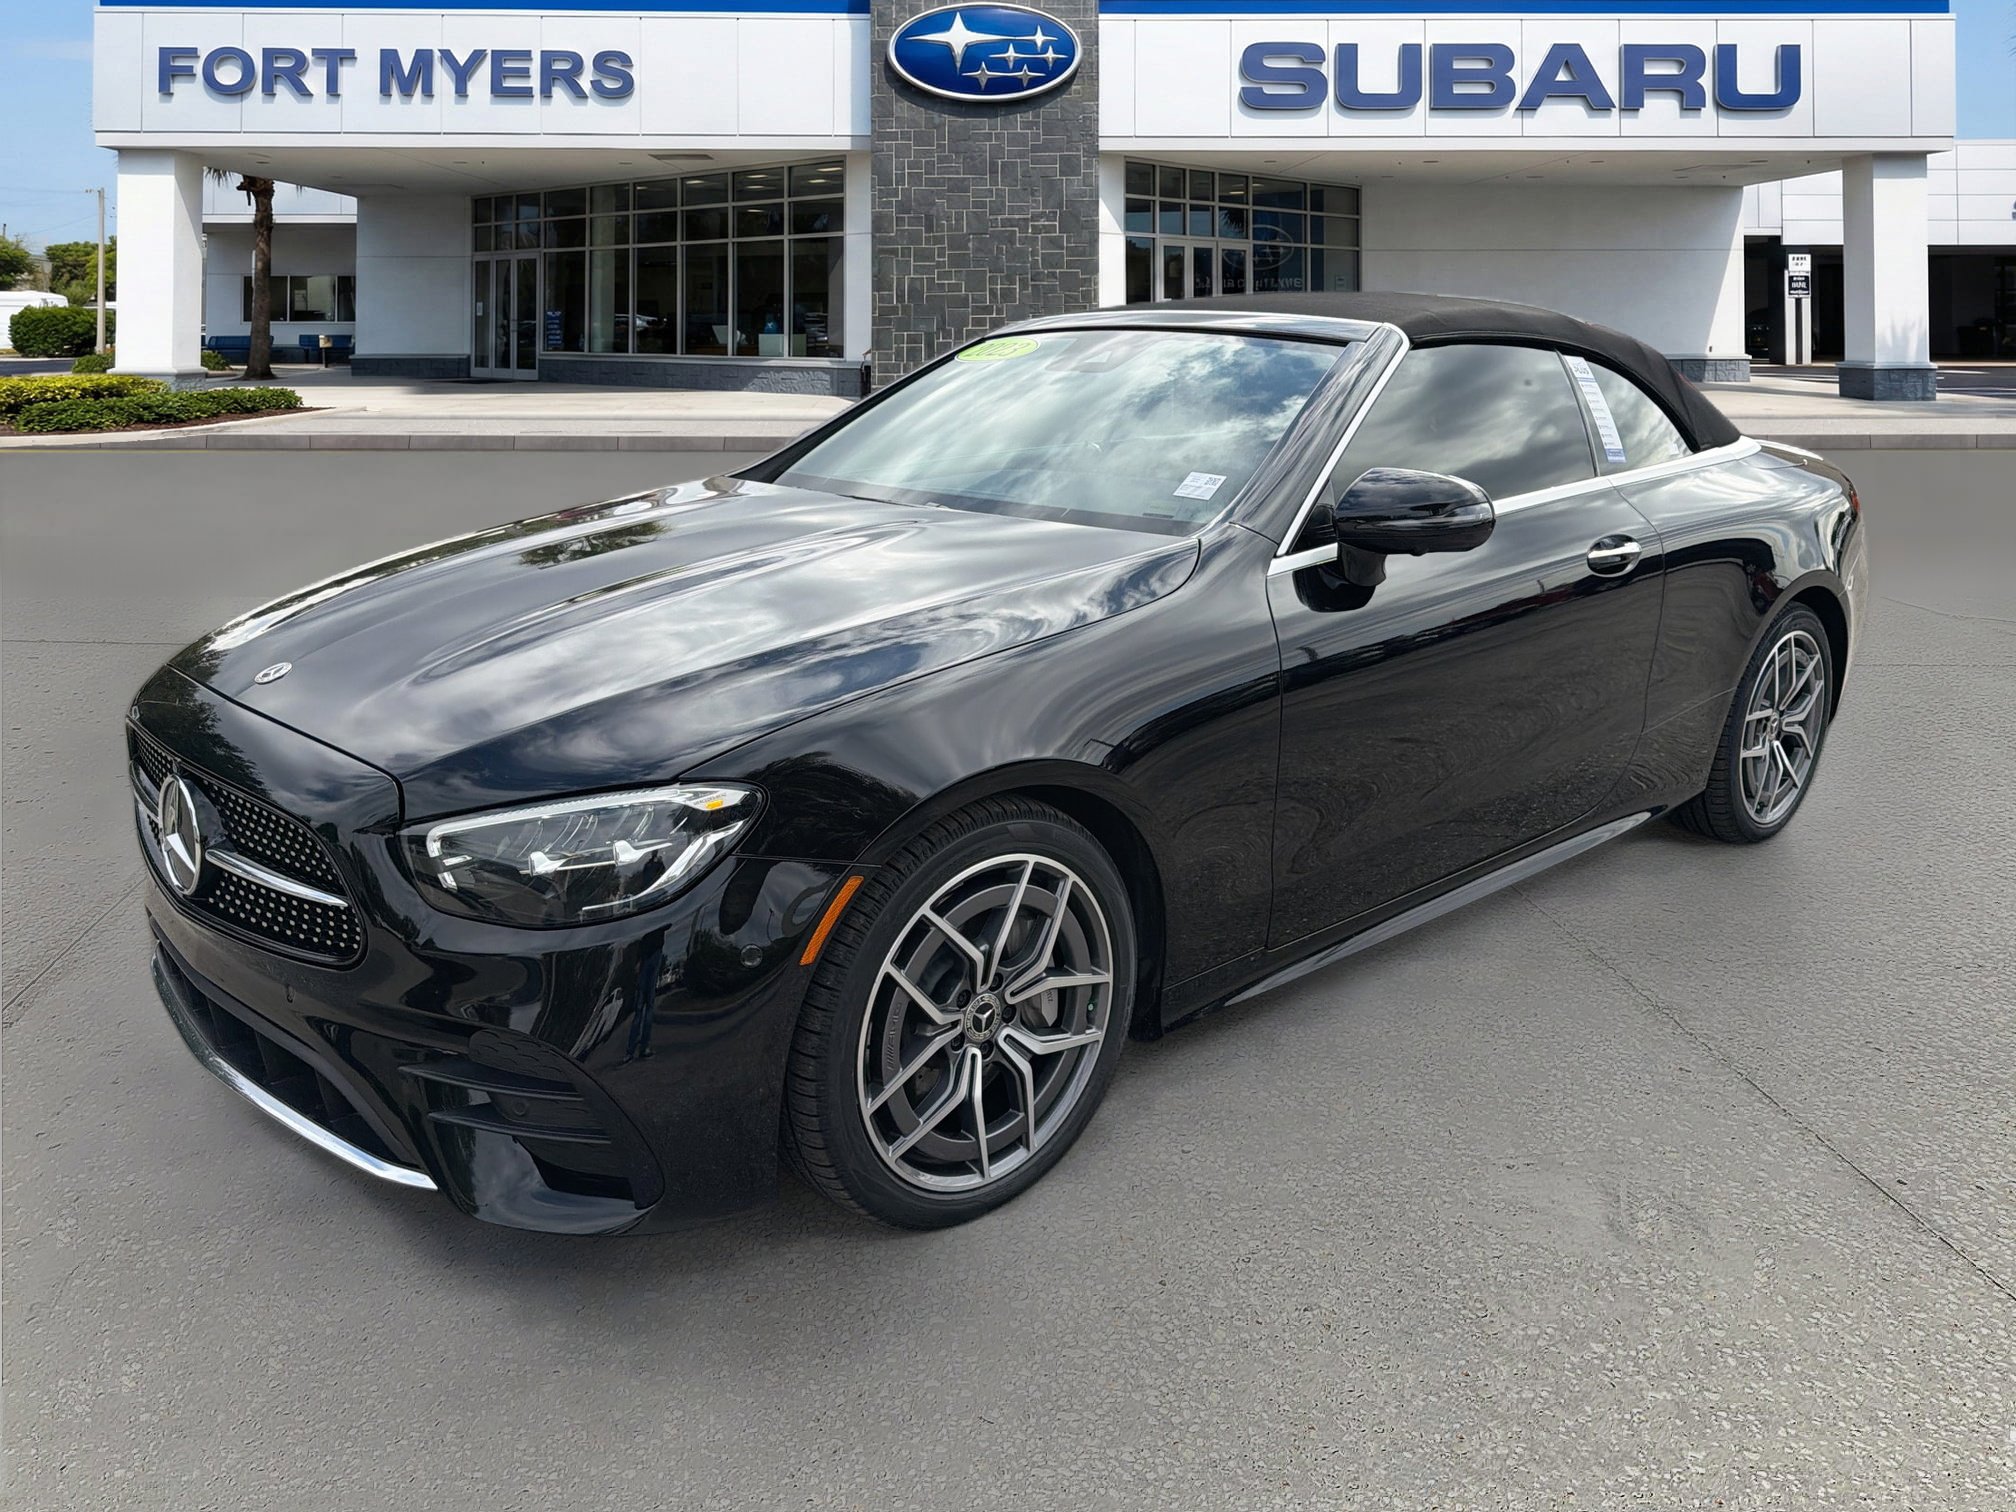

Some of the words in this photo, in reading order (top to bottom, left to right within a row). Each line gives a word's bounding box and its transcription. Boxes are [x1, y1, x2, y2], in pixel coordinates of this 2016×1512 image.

[158, 46, 356, 97] FORT
[379, 48, 636, 99] MYERS
[1238, 42, 1801, 111] SUBARU
